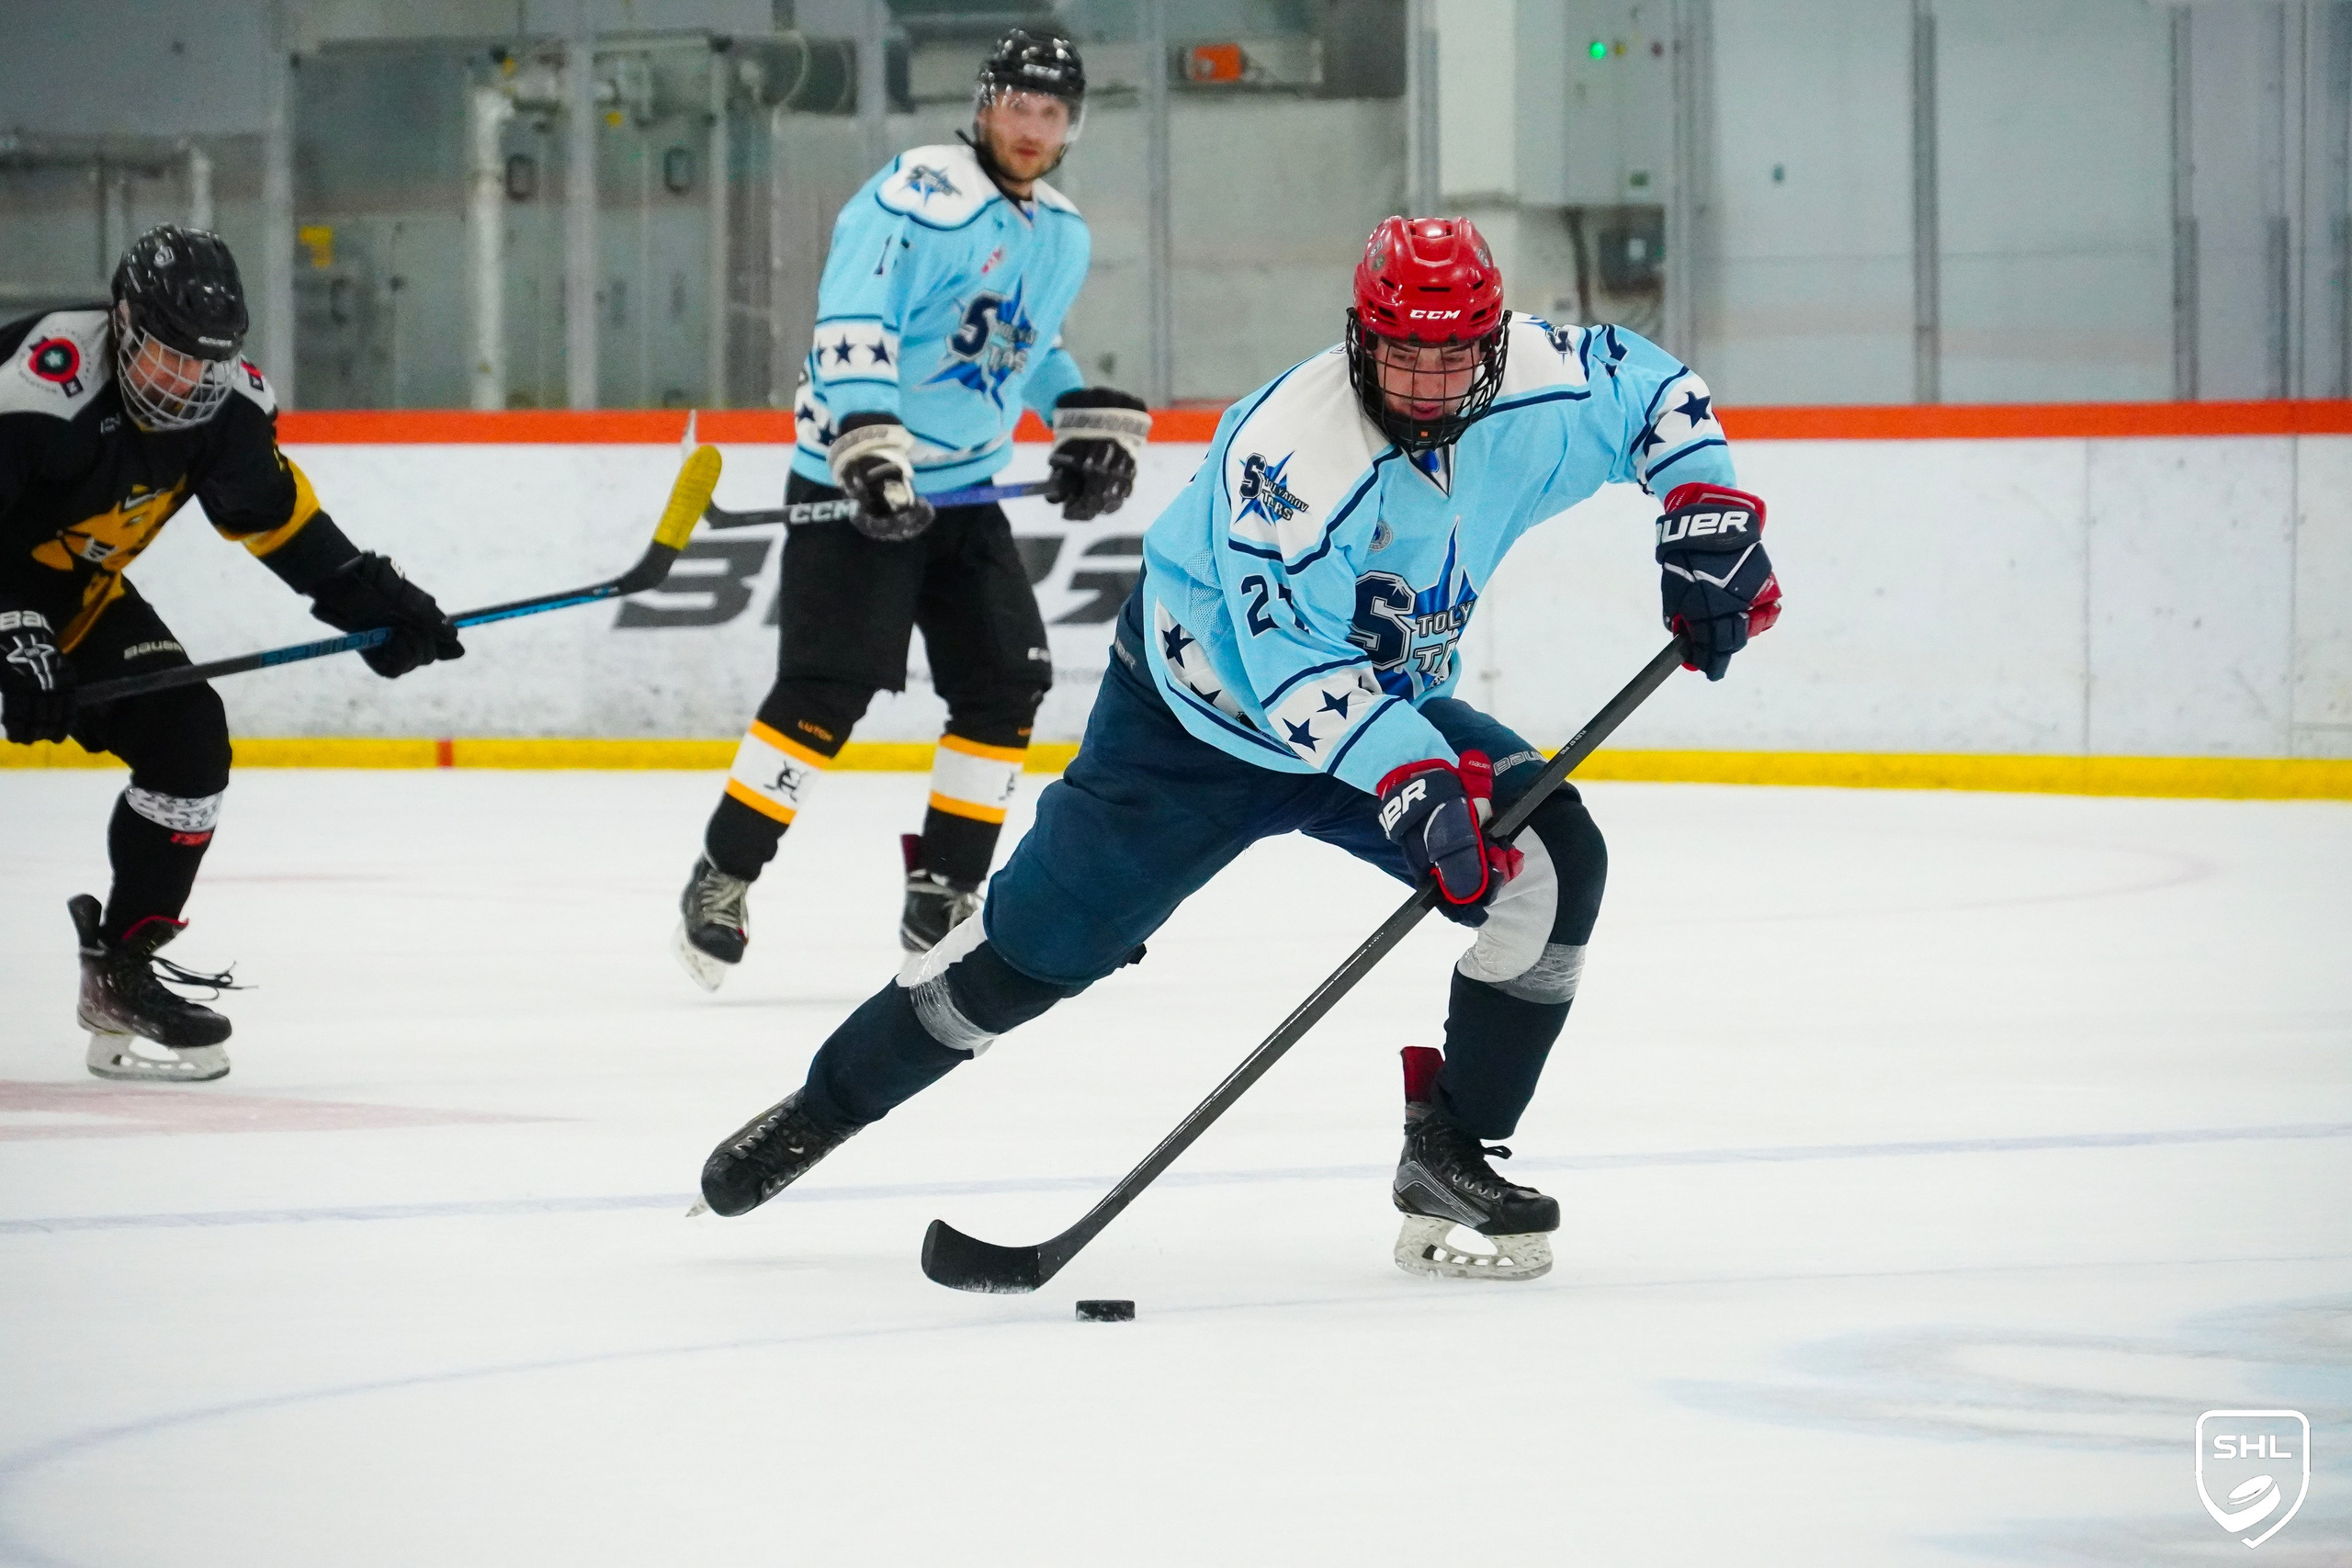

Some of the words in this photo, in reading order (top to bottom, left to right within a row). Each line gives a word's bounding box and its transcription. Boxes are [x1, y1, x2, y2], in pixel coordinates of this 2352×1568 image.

[1409, 309, 1462, 320] CCM
[789, 499, 860, 525] CCM
[0, 610, 55, 635] BA
